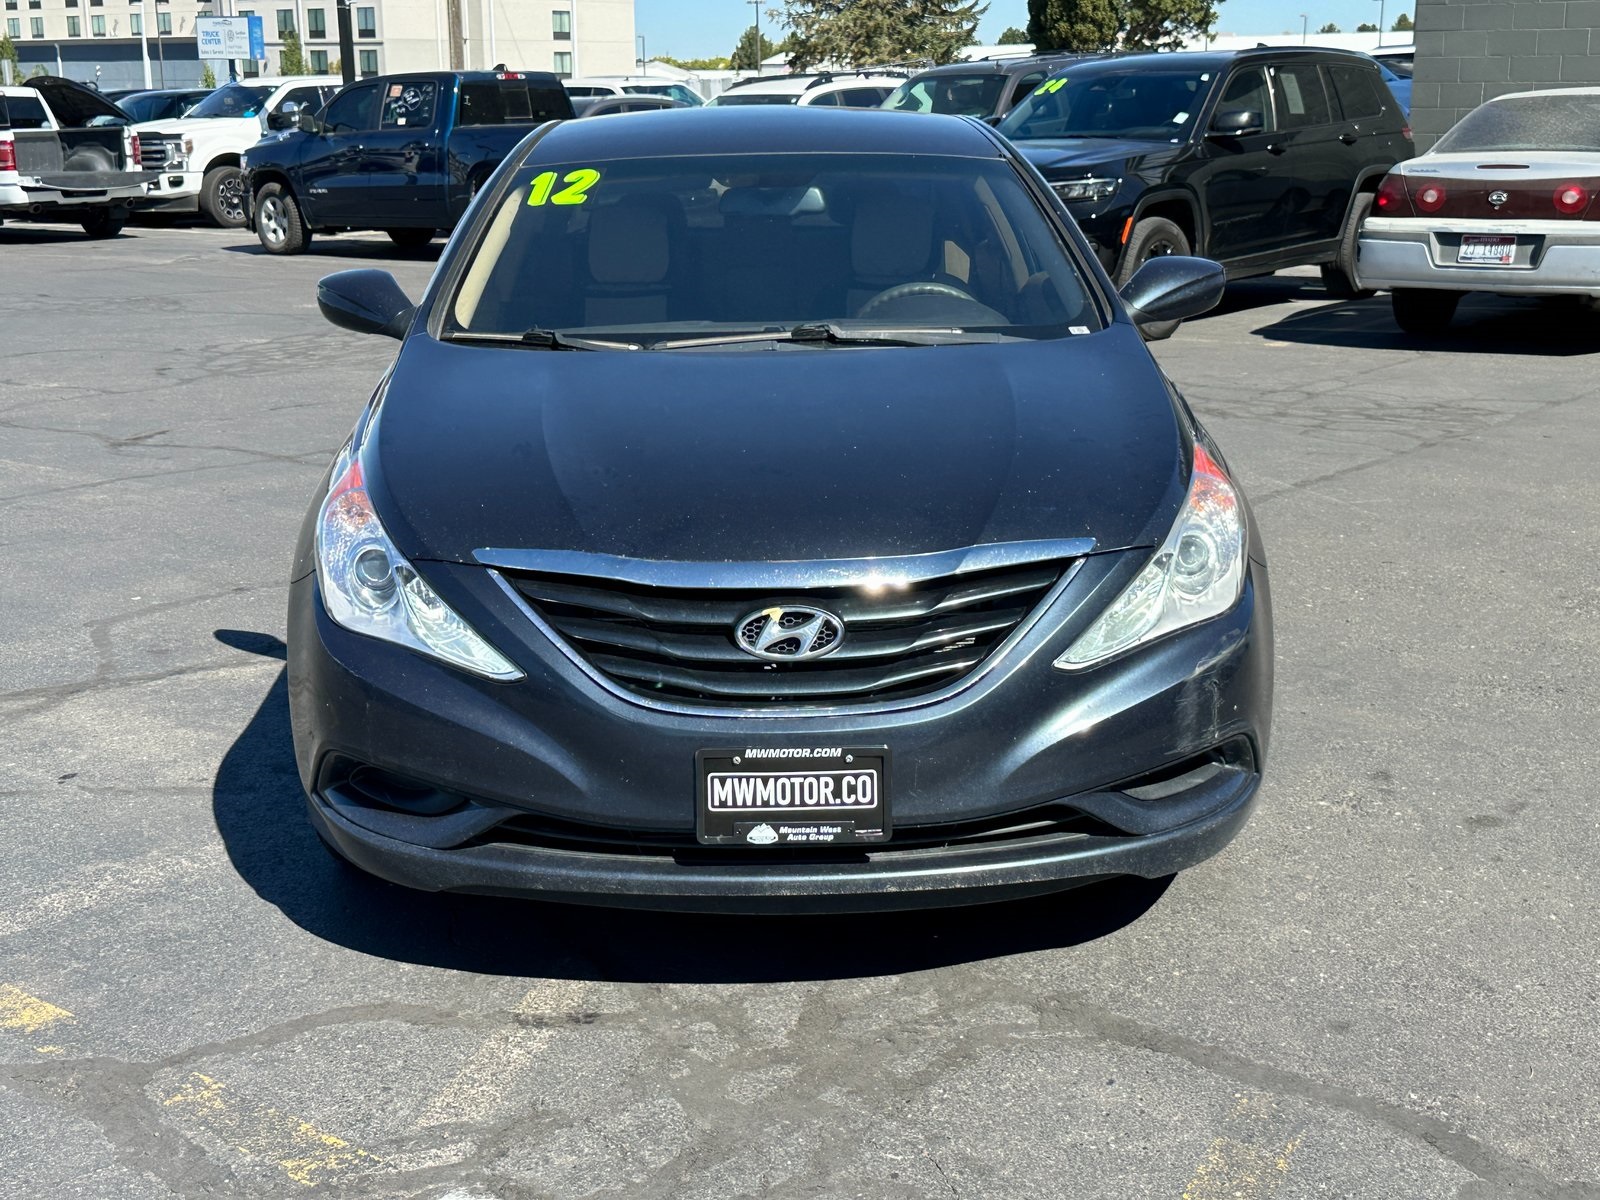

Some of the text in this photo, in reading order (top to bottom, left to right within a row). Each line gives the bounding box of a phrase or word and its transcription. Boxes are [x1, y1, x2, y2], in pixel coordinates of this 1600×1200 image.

[527, 168, 600, 207] 12
[744, 748, 842, 759] MWMOTOR.COM
[713, 775, 872, 806] MWMOTOR.CO
[779, 825, 842, 834] Mountain West
[786, 833, 808, 842] Auto
[808, 833, 835, 842] Group
